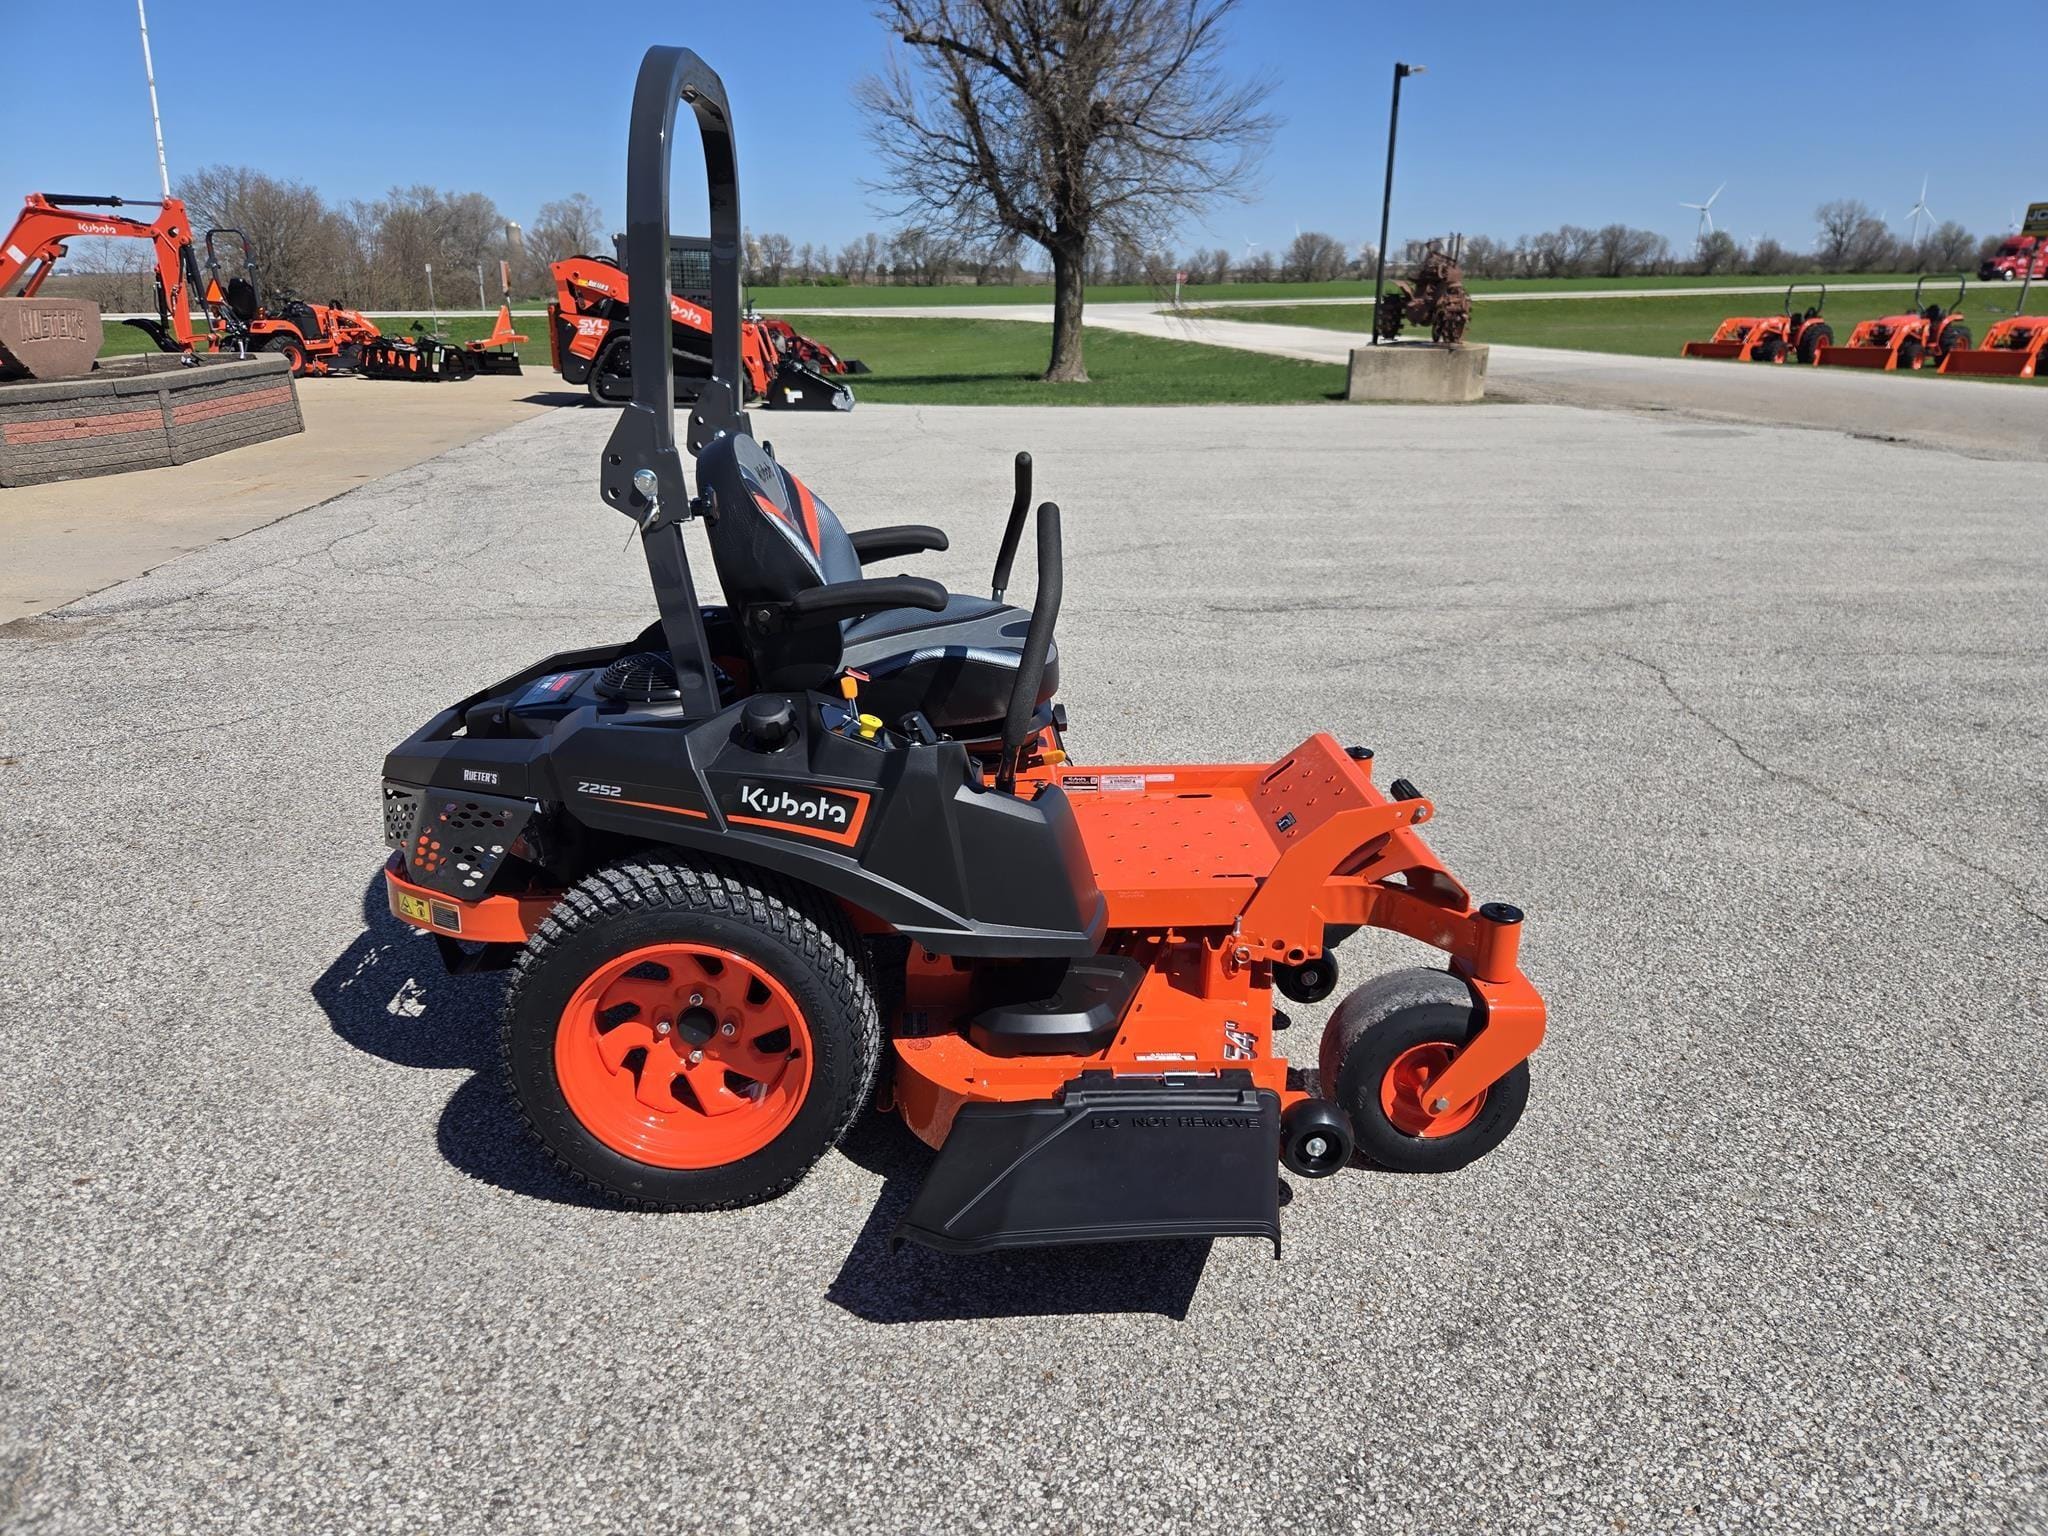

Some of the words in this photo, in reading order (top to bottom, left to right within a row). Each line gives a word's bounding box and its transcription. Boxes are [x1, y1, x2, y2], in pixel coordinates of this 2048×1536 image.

[78, 223, 117, 234] Kubota
[671, 300, 702, 324] bota
[578, 319, 607, 329] SVL
[463, 769, 498, 785] RUETER'S
[577, 781, 622, 797] Z252
[741, 785, 846, 823] Kubota
[1091, 1117, 1121, 1129] DO
[1131, 1116, 1171, 1129] NOT
[1177, 1116, 1261, 1129] REMOVE
